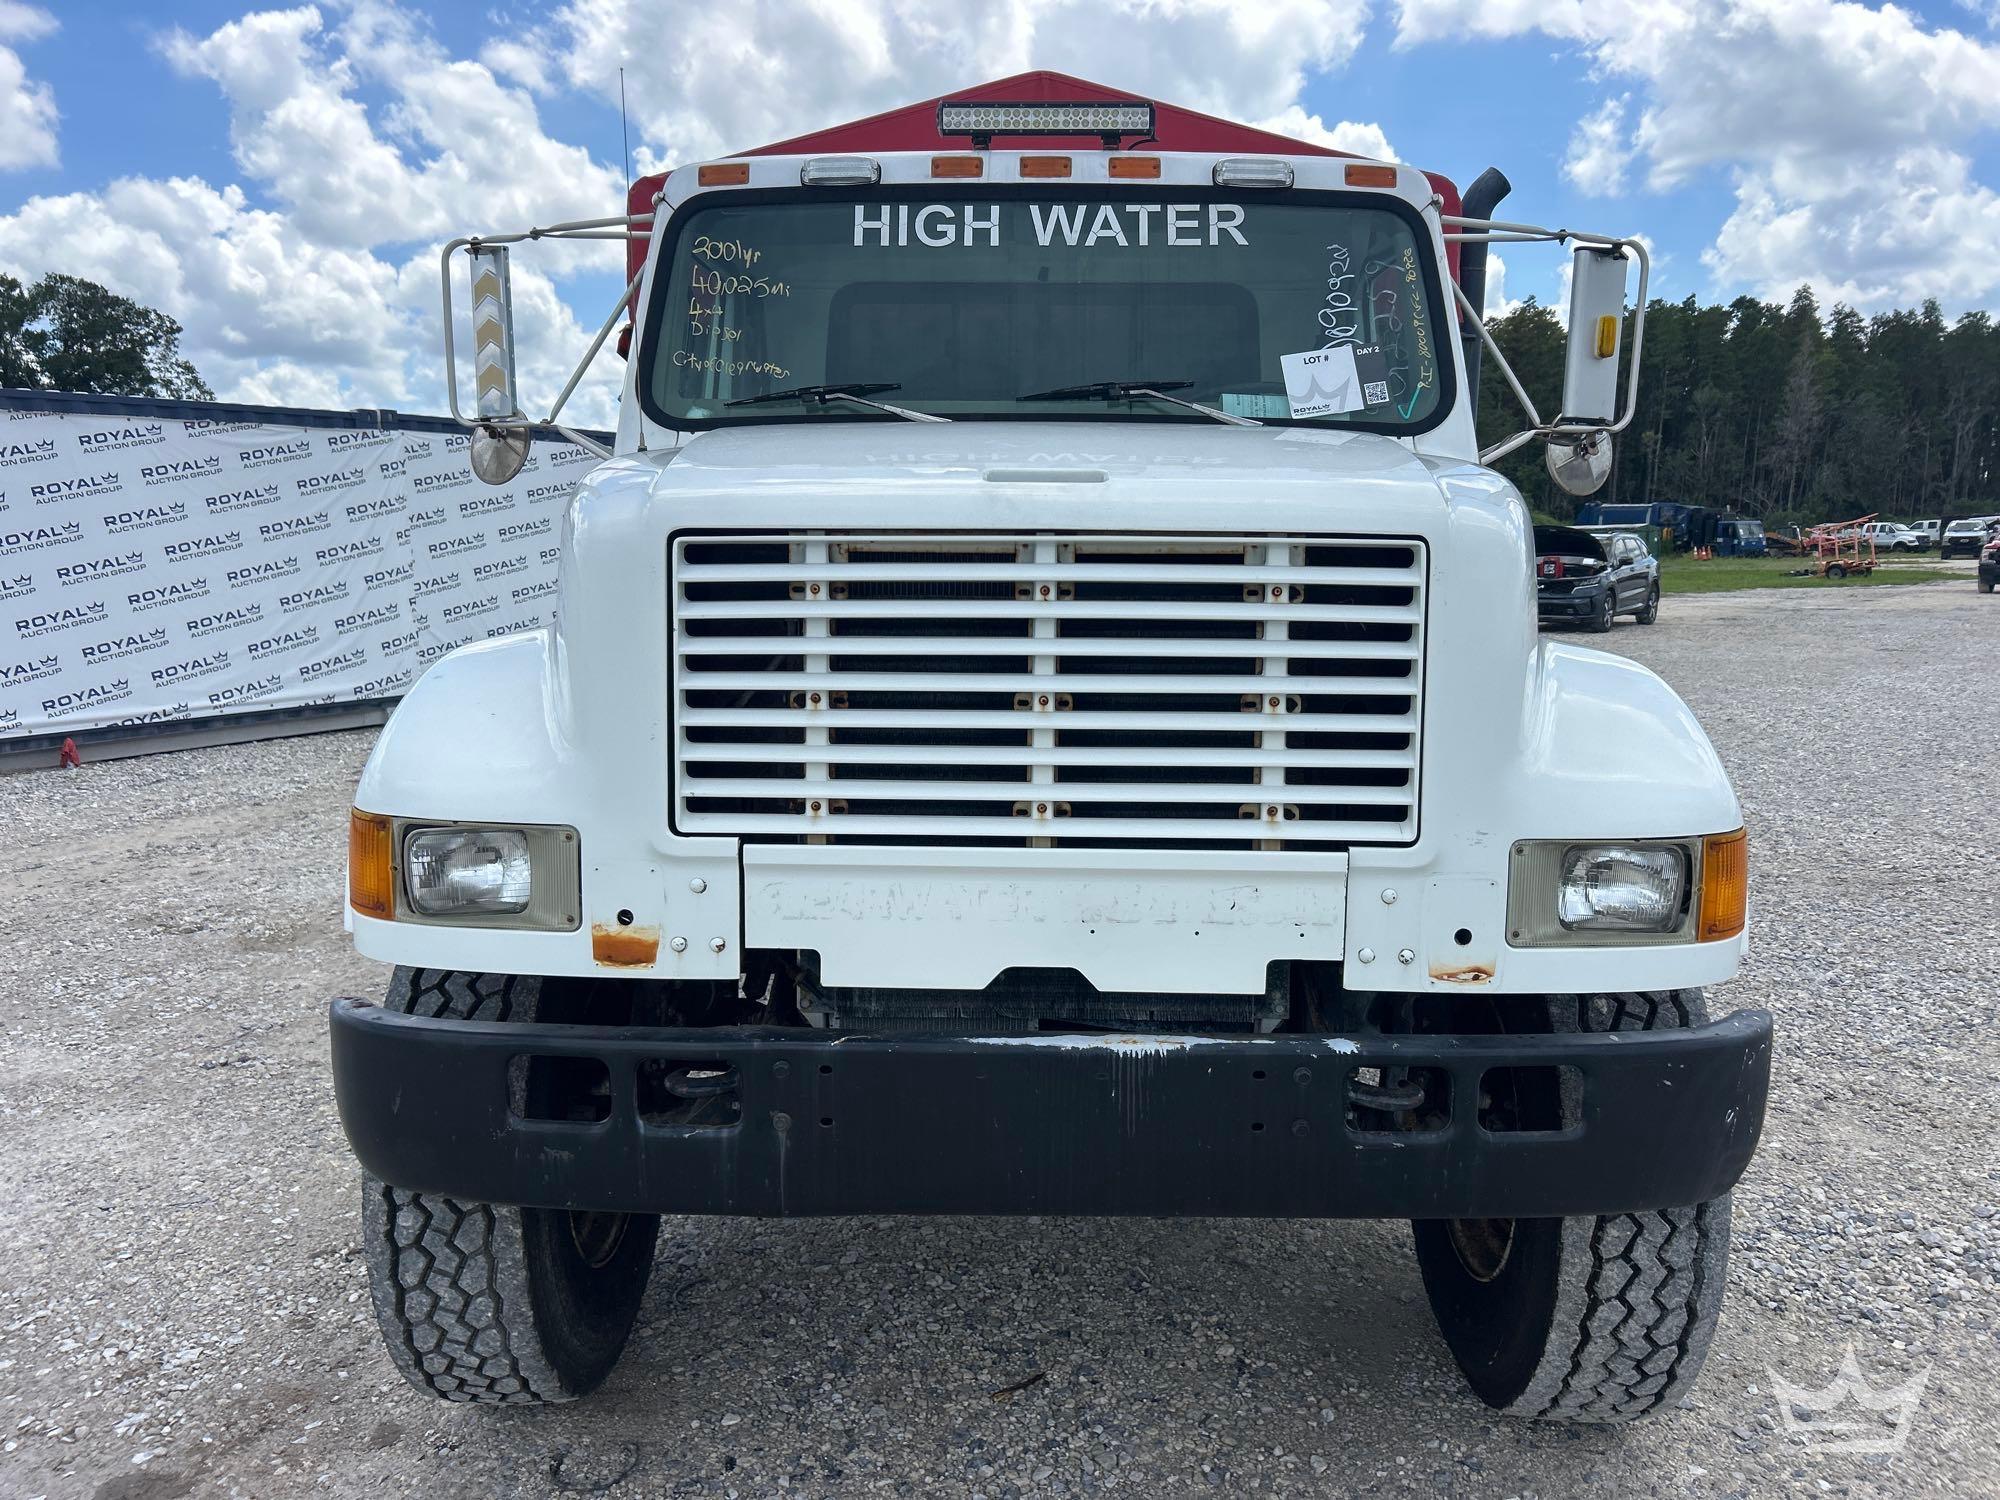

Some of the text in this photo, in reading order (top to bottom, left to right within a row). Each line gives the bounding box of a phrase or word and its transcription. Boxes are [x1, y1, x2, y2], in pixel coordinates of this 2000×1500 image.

[853, 204, 1249, 247] HIGH WATER
[1303, 355, 1321, 365] LOT
[1356, 347, 1372, 356] DAY
[1294, 405, 1323, 413] ROYAL
[79, 428, 146, 445] ROYAL
[188, 423, 263, 439] AUCTION GROUP
[328, 430, 379, 446] ROYAL
[83, 437, 166, 454] AUCTION GROUP
[331, 437, 394, 454] AUCTION GROUP
[446, 435, 471, 447] ROY
[0, 443, 36, 458] YAL
[20, 452, 58, 463] GROUP
[240, 444, 296, 461] ROYAL
[408, 452, 432, 461] GROUP
[551, 448, 589, 461] ROYAL
[141, 460, 205, 478] ROYAL
[243, 452, 312, 469] AUCTION GROUP
[380, 459, 406, 473] ROY
[145, 468, 223, 486] AUCTION GROUP
[297, 472, 350, 489] ROYAL
[414, 472, 459, 487] ROYAL
[31, 477, 102, 497] ROYAL
[35, 485, 122, 505] AUCTION GROUP
[300, 480, 366, 497] AUCTION GROUP
[417, 482, 448, 494] AUCTION
[527, 484, 566, 498] ROYAL
[206, 489, 264, 507] ROYAL
[209, 496, 282, 515] AUCTION GROUP
[346, 498, 395, 516] ROYAL
[460, 497, 503, 512] ROYAL
[529, 494, 557, 504] AUCTION
[104, 507, 169, 527] ROYAL
[349, 505, 406, 523] AUCTION GROUP
[409, 511, 433, 523] YAL
[462, 507, 492, 518] AUCTION
[108, 515, 189, 535] AUCTION GROUP
[259, 516, 315, 535] ROYAL
[422, 518, 447, 527] GROUP
[498, 522, 540, 537] ROYAL
[0, 527, 62, 547] OYAL
[263, 523, 331, 542] AUCTION GROUP
[501, 532, 530, 543] AUCTION
[0, 534, 84, 556] UCTION GROUP
[165, 536, 226, 555] ROYAL
[169, 542, 243, 563] AUCTION GROUP
[316, 540, 369, 560] ROYAL
[429, 536, 474, 553] ROYAL
[319, 547, 384, 567] AUCTION GROUP
[432, 548, 463, 560] AUCTION
[57, 557, 127, 578] ROYAL
[62, 563, 147, 587] AUCTION GROUP
[227, 561, 285, 581] ROYAL
[364, 565, 409, 585] ROYAL
[474, 559, 517, 576] ROYAL
[477, 571, 505, 582] AUCTION
[230, 567, 301, 589] AUCTION GROUP
[367, 578, 400, 591] AUCTION
[413, 576, 448, 592] OYAL
[128, 583, 193, 605] ROYAL
[279, 586, 334, 607] ROYAL
[437, 582, 462, 593] GROUP
[512, 581, 552, 599] ROYAL
[132, 589, 211, 613] AUCTION GROUP
[283, 591, 350, 614] AUCTION GROUP
[443, 599, 488, 618] ROYAL
[514, 594, 543, 605] AUCTION
[15, 607, 88, 632] ROYAL
[187, 609, 247, 631] ROYAL
[191, 614, 264, 639] AUCTION GROUP
[335, 608, 386, 629] ROYAL
[338, 613, 400, 636] AUCTION GROUP
[446, 611, 477, 624] AUCTION
[20, 614, 109, 640] AUCTION GROUP
[487, 619, 530, 638] ROYAL
[82, 634, 150, 658] ROYAL
[248, 632, 304, 654] ROYAL
[251, 637, 320, 661] AUCTION GROUP
[87, 640, 169, 666] AUCTION GROUP
[0, 662, 41, 679] YAL
[151, 657, 214, 681] ROYAL
[299, 653, 352, 676] ROYAL
[302, 658, 368, 683] AUCTION GROUP
[23, 667, 62, 682] GROUP
[155, 662, 232, 688] AUCTION GROUP
[208, 680, 268, 704] ROYAL
[353, 673, 403, 696] ROYAL
[356, 686, 390, 701] AUCTION
[42, 685, 112, 712] ROYAL
[47, 690, 133, 719] AUCTION GROUP
[212, 685, 285, 710] AUCTION GROUP
[107, 709, 172, 728] OYAL
